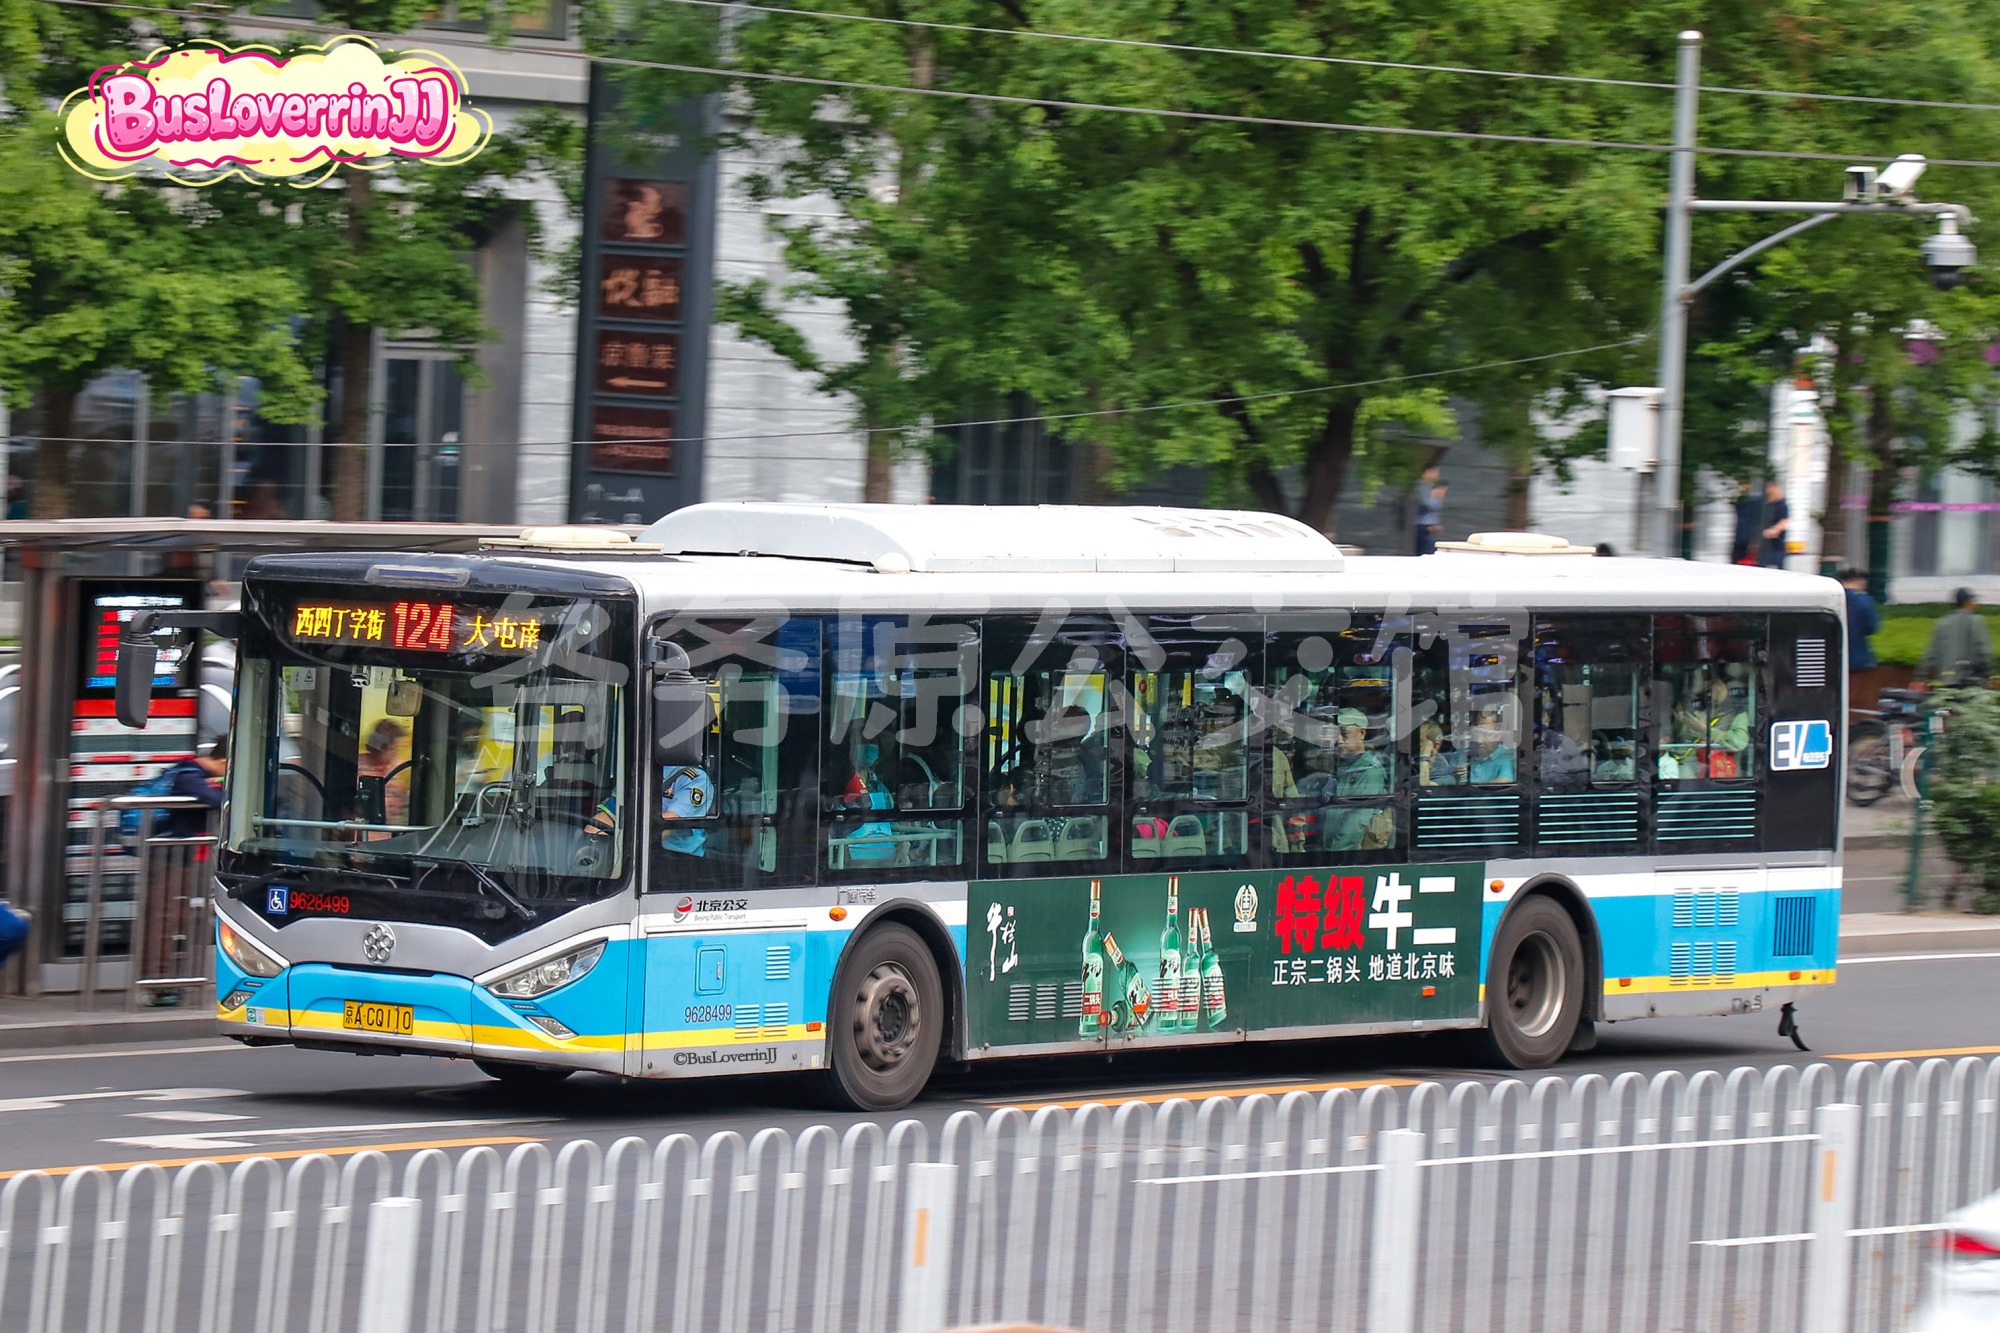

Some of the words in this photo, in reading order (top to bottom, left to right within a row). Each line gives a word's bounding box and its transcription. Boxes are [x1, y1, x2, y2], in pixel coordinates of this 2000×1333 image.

[295, 607, 386, 640] 西四丁字街
[395, 602, 453, 650] 124
[463, 616, 541, 650] 大屯南
[289, 892, 350, 914] 9628499
[696, 899, 748, 912] 北京公交
[724, 912, 746, 920] Transport
[1275, 873, 1366, 955] 特级
[1368, 871, 1456, 951] 牛二
[1271, 955, 1361, 986] 正宗二锅头
[1367, 951, 1456, 982] 地道北京味
[685, 1004, 732, 1024] 9628499
